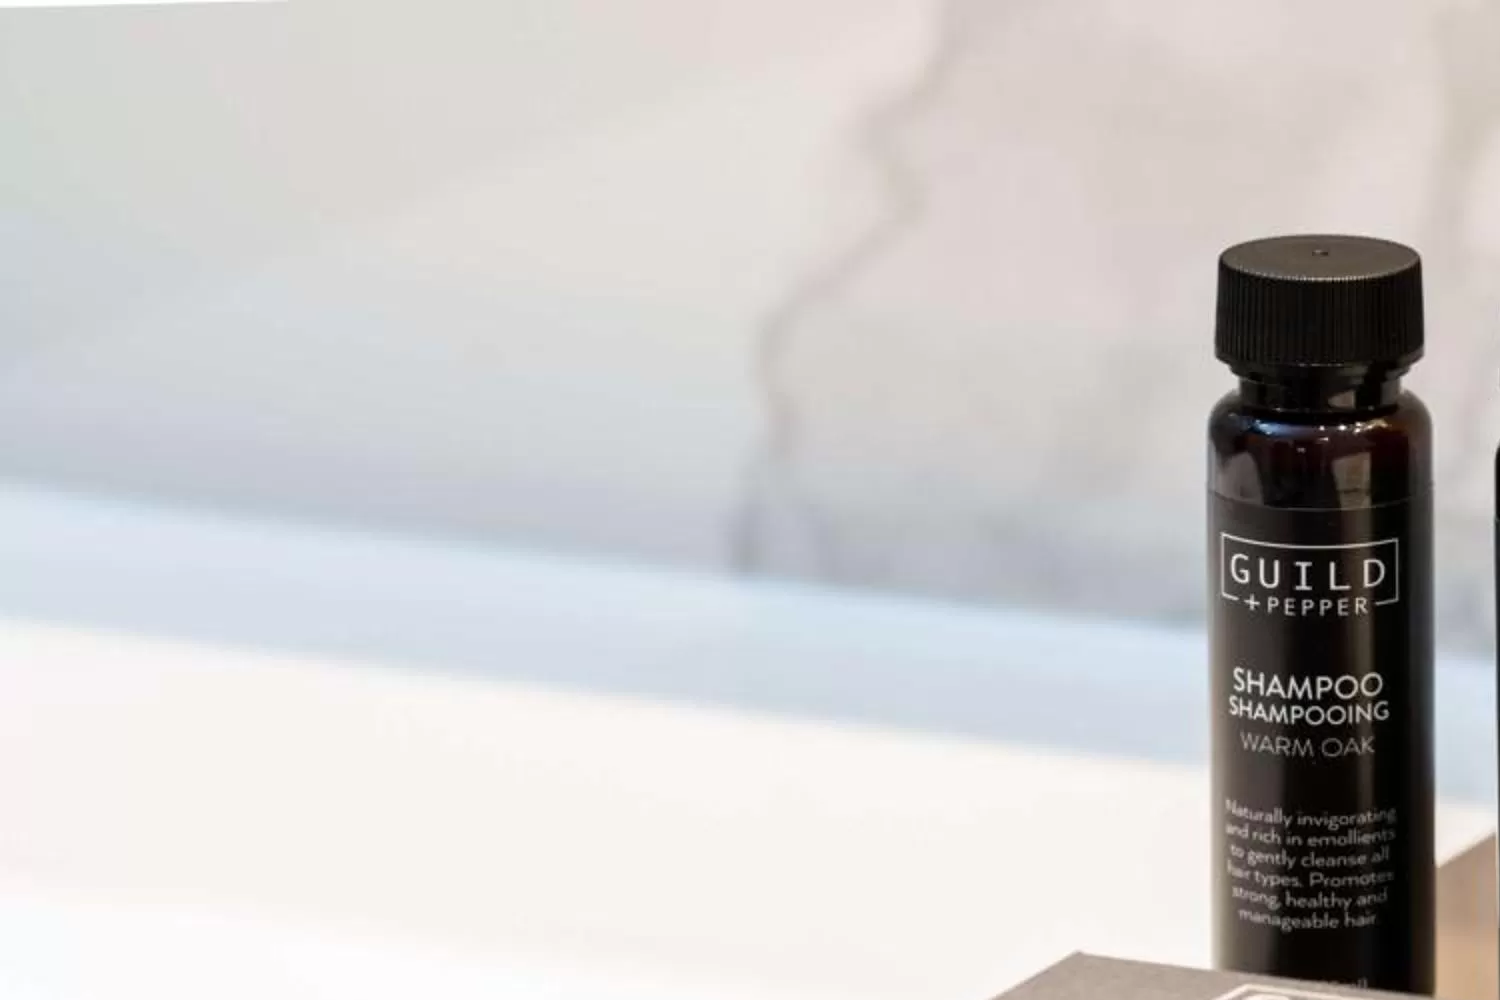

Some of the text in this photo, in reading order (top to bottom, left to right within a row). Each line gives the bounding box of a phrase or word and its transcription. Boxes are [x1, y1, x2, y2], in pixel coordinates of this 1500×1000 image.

[1231, 553, 1385, 591] GUILD
[1233, 667, 1383, 699] SHAMPOO
[1229, 696, 1389, 725] SHAMPOOING
[1240, 733, 1375, 757] WARM OAK
[1225, 799, 1292, 827] Naturally
[1253, 828, 1281, 844] rich
[1287, 832, 1302, 846] in
[1231, 844, 1244, 858] to
[1248, 849, 1296, 869] gently
[1301, 853, 1366, 868] cleanse
[1285, 892, 1352, 910] healthy
[1357, 887, 1388, 904] and
[1239, 909, 1339, 932] manageable
